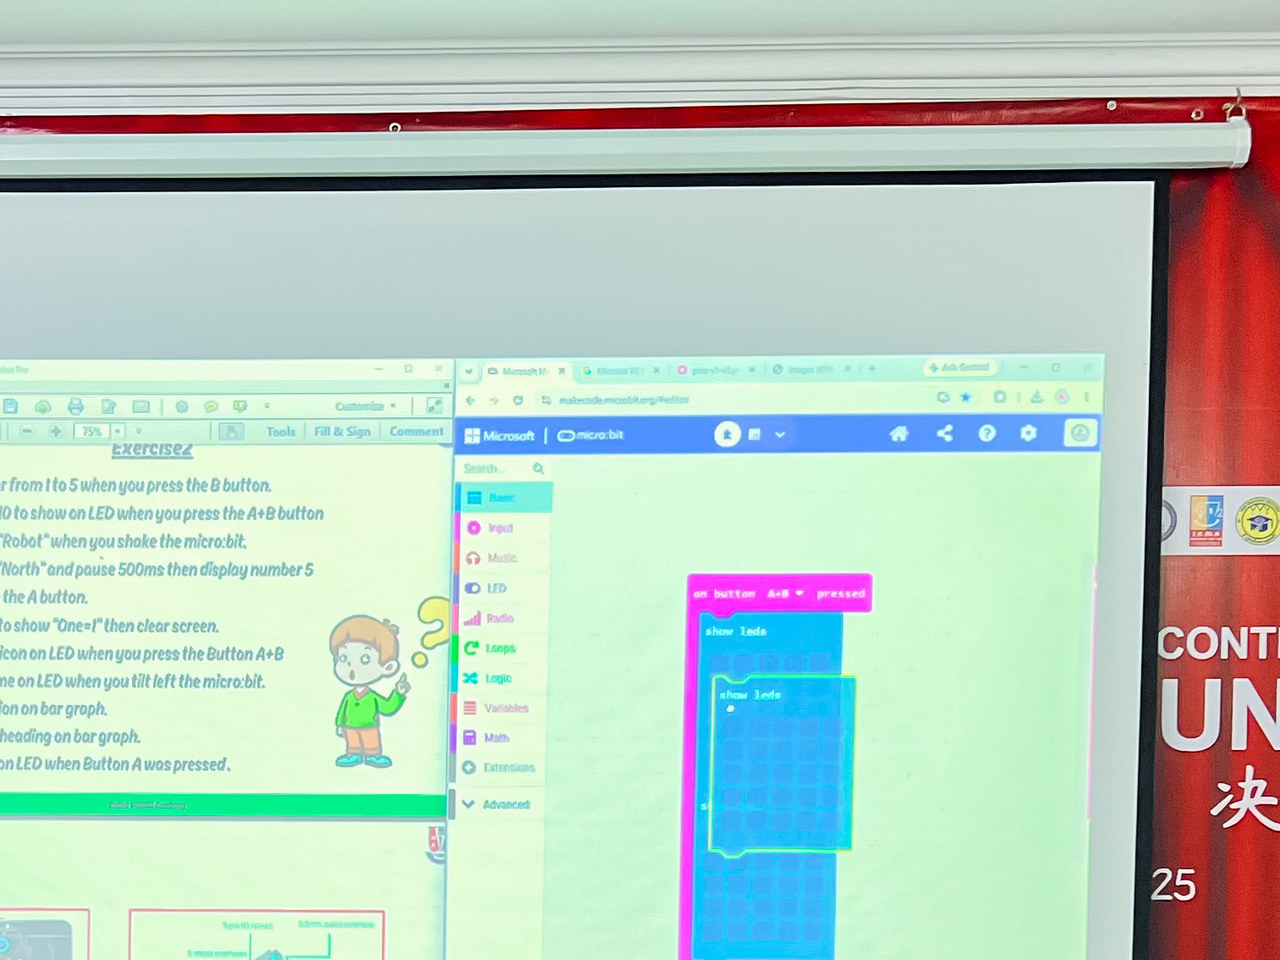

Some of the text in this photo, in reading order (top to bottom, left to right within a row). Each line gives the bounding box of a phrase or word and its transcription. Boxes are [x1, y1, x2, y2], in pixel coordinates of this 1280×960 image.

[336, 402, 384, 411] Customize
[82, 426, 103, 436] 75%
[267, 426, 296, 437] Tools
[315, 426, 371, 438] Fill & Sign
[390, 426, 444, 437] Comment
[484, 430, 535, 441] Microsoft
[576, 429, 623, 440] micro:bit
[9, 478, 42, 492] from
[53, 478, 67, 492] to
[69, 478, 78, 492] 5
[81, 478, 117, 492] when
[118, 481, 144, 495] you
[147, 481, 183, 495] press
[186, 478, 208, 492] the
[211, 478, 220, 492] B
[223, 478, 272, 492] button.
[14, 506, 28, 520] to
[31, 506, 66, 520] show
[69, 509, 86, 520] on
[88, 506, 114, 520] LED
[117, 506, 153, 520] when
[156, 509, 181, 524] you
[183, 508, 220, 523] press
[223, 506, 245, 520] the
[247, 506, 275, 520] A+B
[278, 506, 324, 520] button
[489, 523, 513, 534] Input
[51, 534, 87, 548] when
[89, 537, 115, 551] you
[117, 534, 157, 548] shake
[160, 534, 181, 549] the
[488, 553, 517, 563] Music
[487, 583, 507, 593] LED
[693, 589, 789, 598] on button A+B
[817, 589, 865, 600] pressed
[487, 614, 514, 623] Radio
[14, 618, 49, 632] show
[104, 618, 134, 632] then
[137, 619, 170, 633] clear
[172, 621, 219, 633] screen.
[705, 626, 766, 636] show leds
[1158, 626, 1280, 660] CONT
[486, 644, 516, 657] Loops
[17, 677, 34, 688] on
[37, 674, 62, 688] LED
[66, 673, 101, 688] when
[104, 677, 129, 691] you
[132, 673, 151, 688] tilt
[153, 674, 176, 688] left
[179, 674, 200, 688] the
[486, 674, 512, 685] Logic
[720, 690, 781, 700] show leds
[21, 704, 38, 716] on
[40, 701, 63, 716] bar
[66, 701, 107, 719] graph.
[485, 703, 529, 713] Variables
[485, 733, 509, 742] Math
[484, 763, 535, 772] Extensions
[483, 800, 530, 809] Advanced
